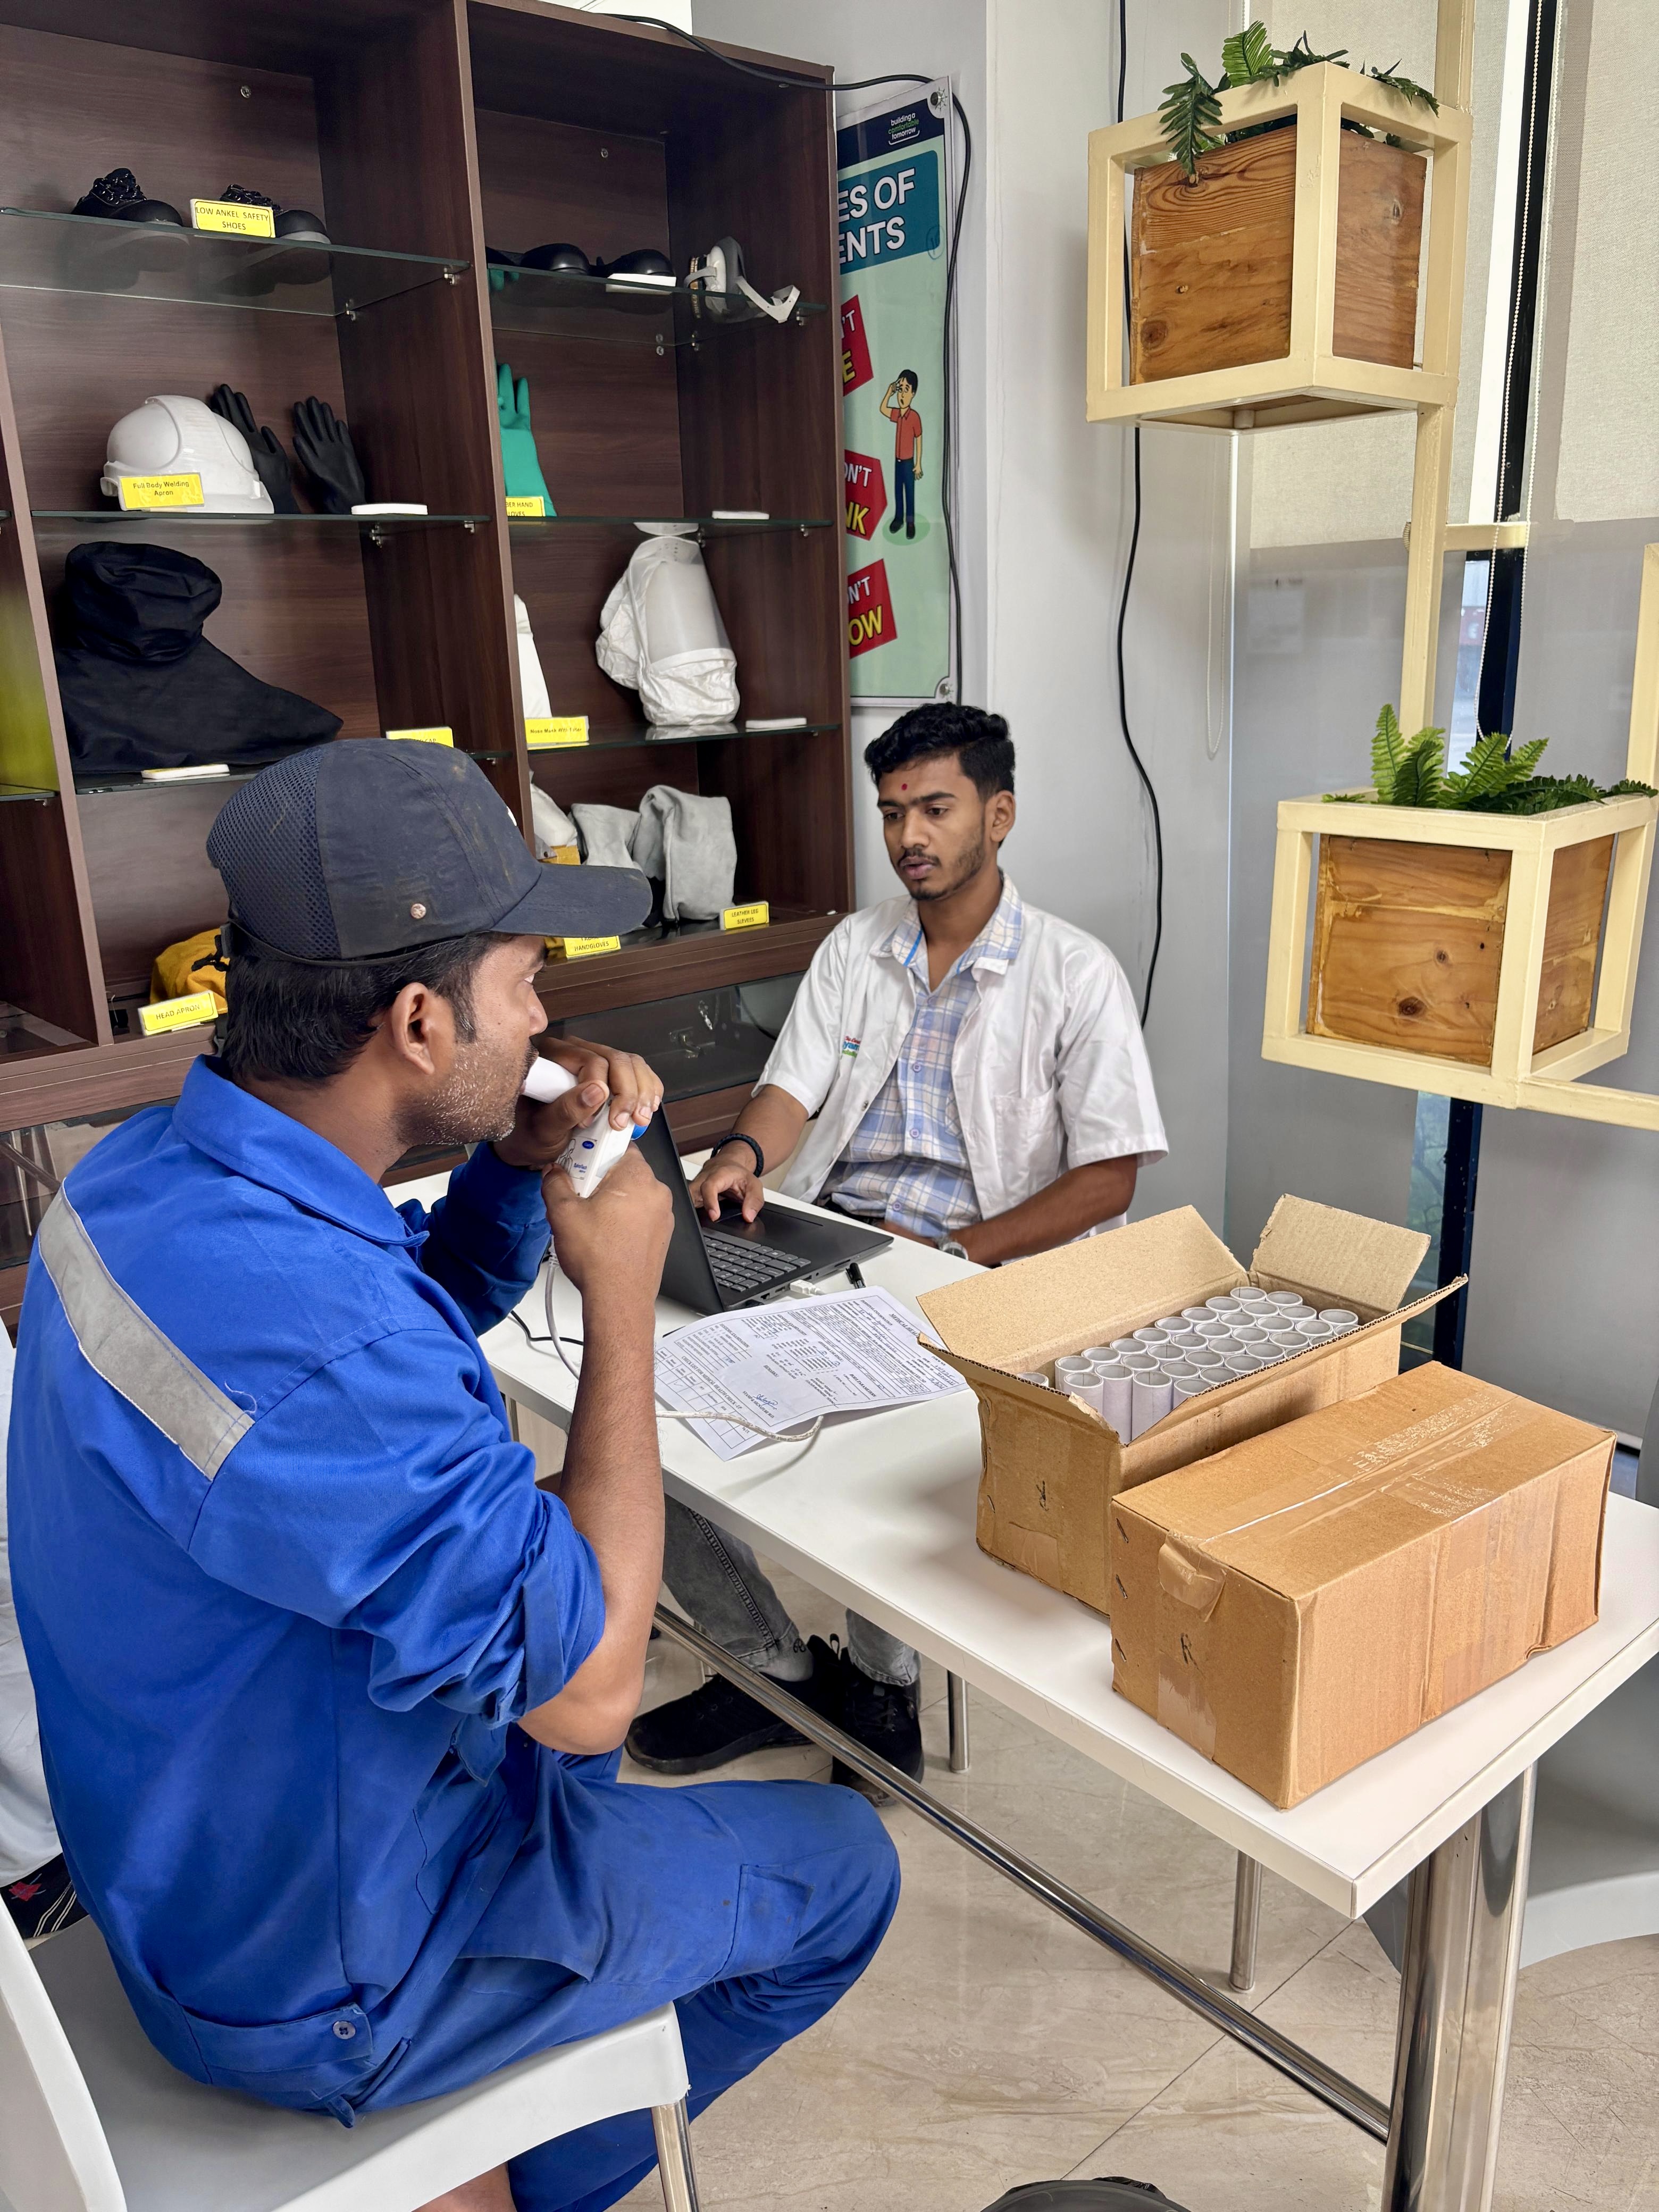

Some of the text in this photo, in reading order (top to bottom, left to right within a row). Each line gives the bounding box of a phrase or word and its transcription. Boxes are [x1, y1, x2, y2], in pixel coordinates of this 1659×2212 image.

[888, 119, 919, 135] comfortable
[892, 127, 916, 140] tomorrow
[874, 168, 915, 210] OF
[216, 209, 239, 218] ANKEL
[243, 212, 268, 221] SAFETY
[222, 221, 246, 230] SHOES
[574, 941, 609, 951] HANDGLOVES
[156, 1004, 200, 1020] HEAD APRON
